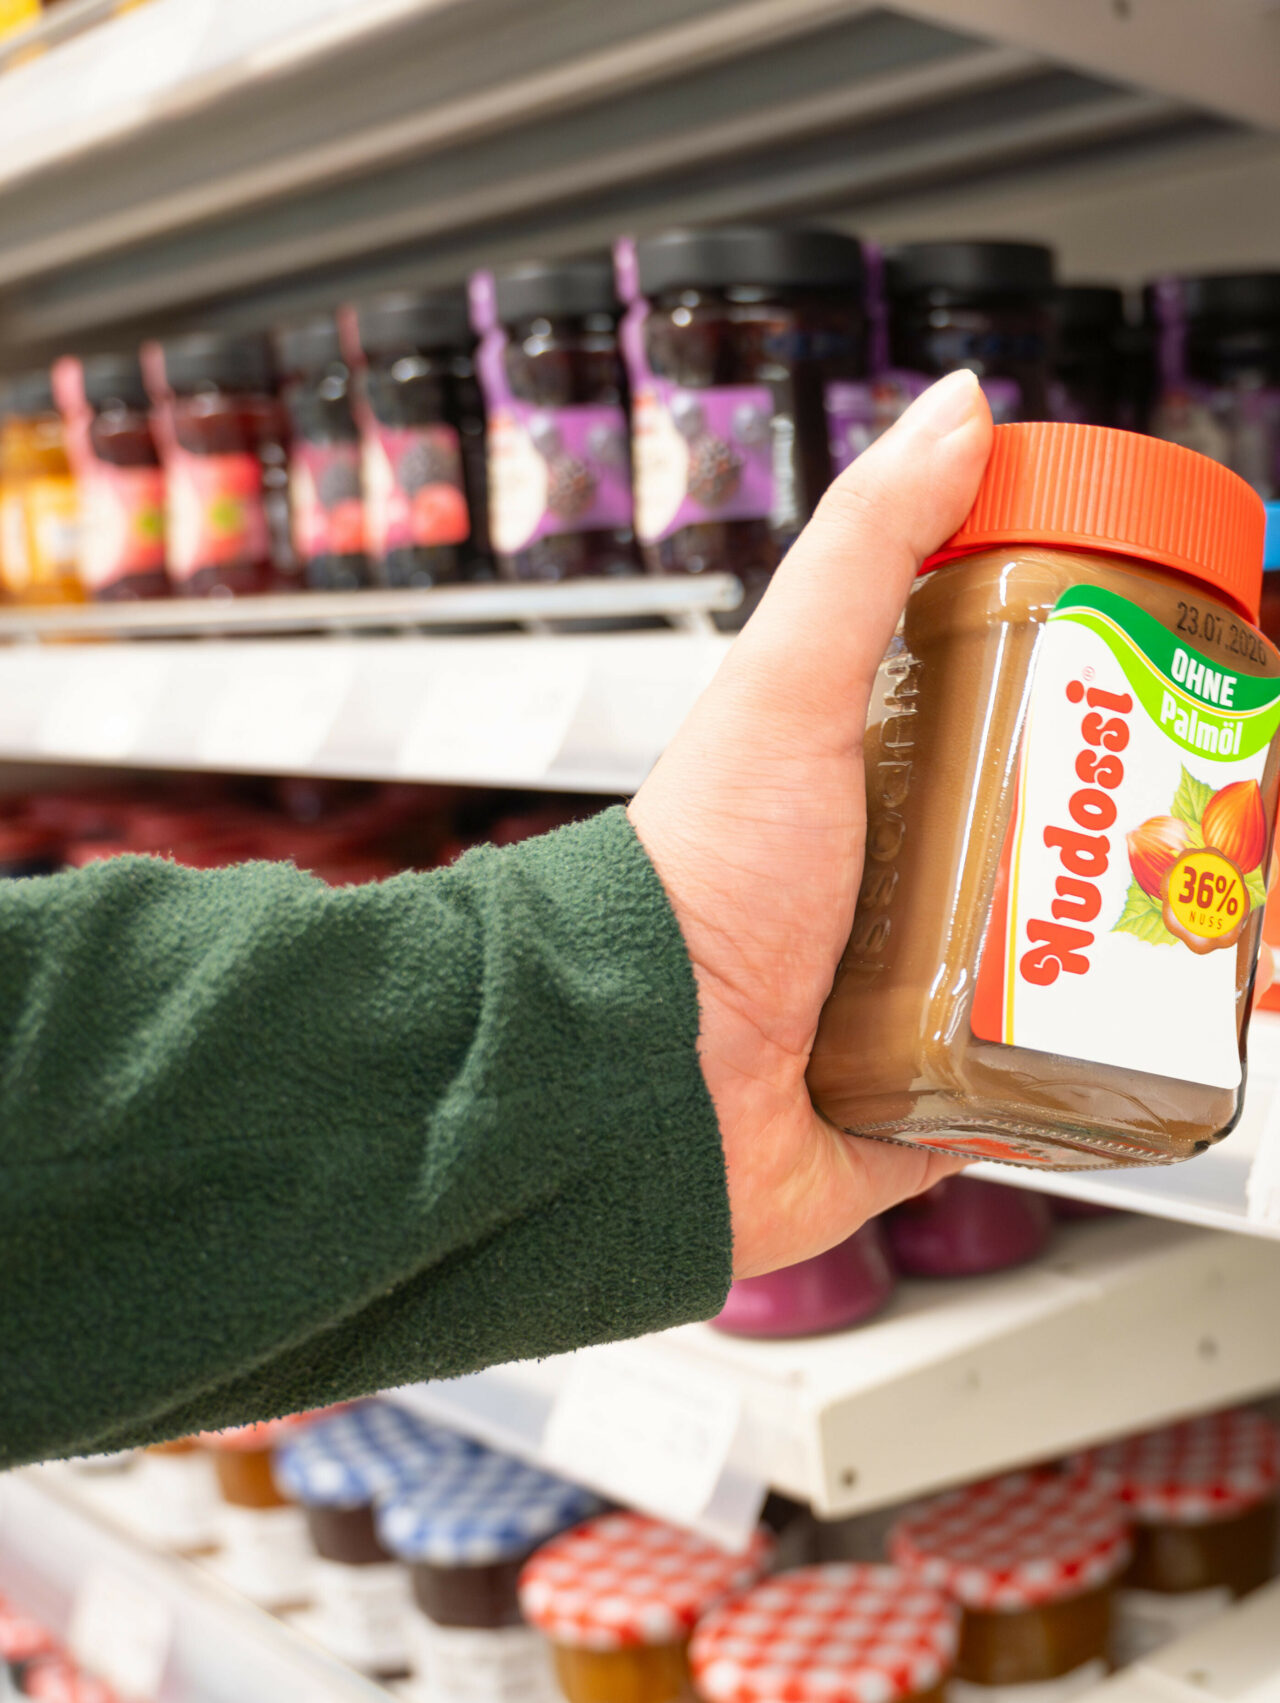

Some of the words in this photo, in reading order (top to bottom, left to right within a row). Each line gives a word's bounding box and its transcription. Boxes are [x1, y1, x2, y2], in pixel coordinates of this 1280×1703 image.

[1171, 648, 1237, 707] OHNE
[1160, 690, 1243, 755] Palmöl
[1019, 679, 1133, 986] Nudossi
[1178, 866, 1238, 916] 36%
[1189, 911, 1223, 930] NUSS
